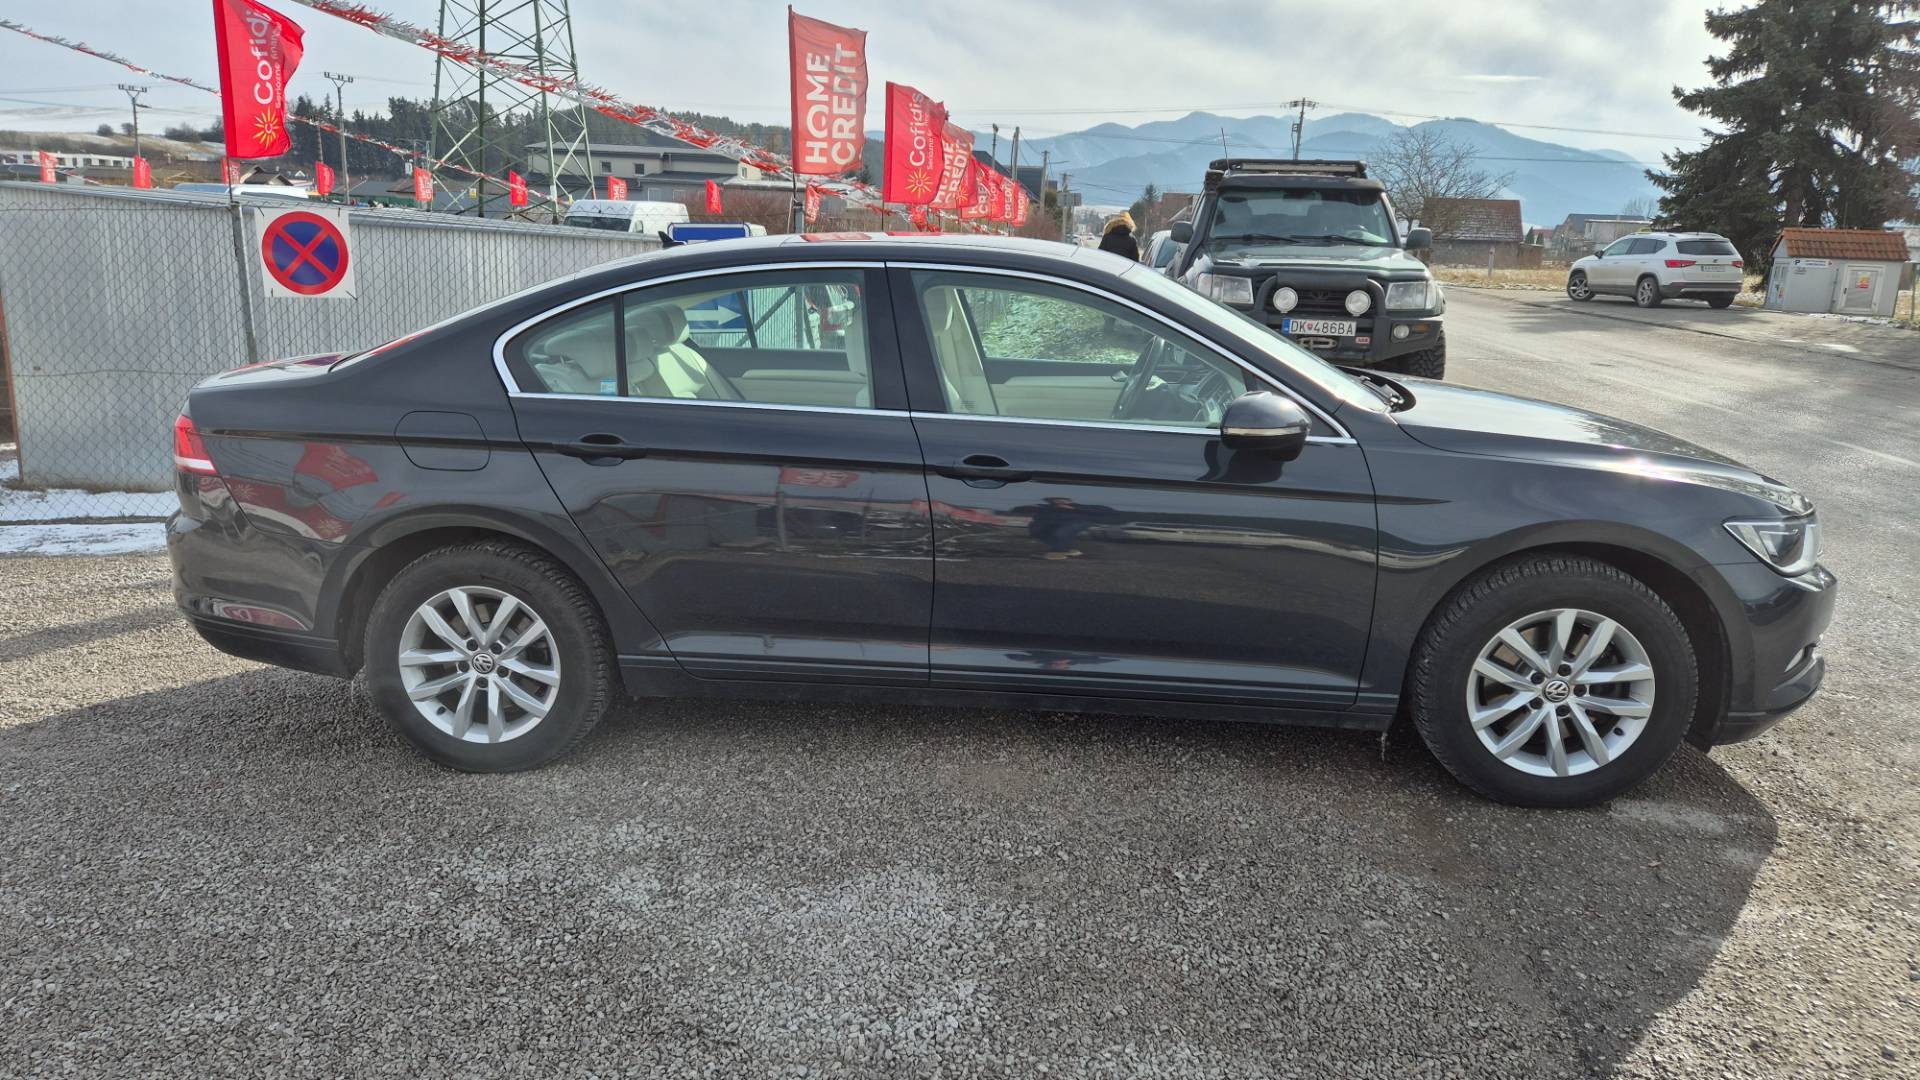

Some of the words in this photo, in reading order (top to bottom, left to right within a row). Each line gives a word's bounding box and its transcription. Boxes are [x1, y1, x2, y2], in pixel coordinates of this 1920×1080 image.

[805, 52, 831, 164] HOME
[831, 42, 857, 165] CREDIT
[910, 93, 926, 167] Cofidis
[1313, 321, 1353, 336] 486BA
